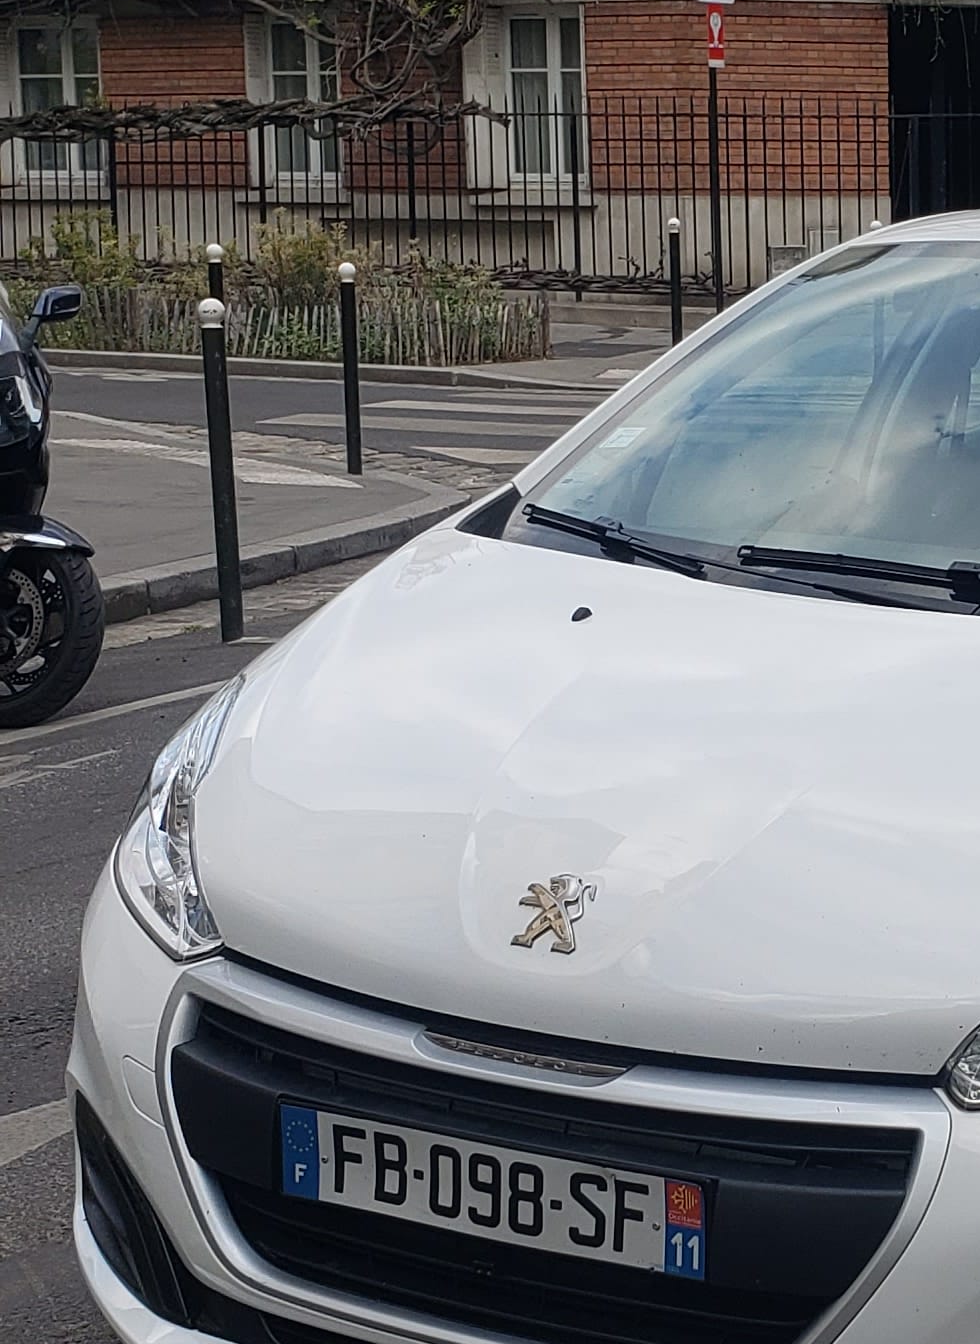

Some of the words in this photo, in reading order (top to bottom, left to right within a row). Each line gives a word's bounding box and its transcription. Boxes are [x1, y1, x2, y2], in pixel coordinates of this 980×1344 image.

[293, 1163, 308, 1184] F
[332, 1123, 650, 1253] FB-098-SF
[670, 1232, 700, 1271] 11
